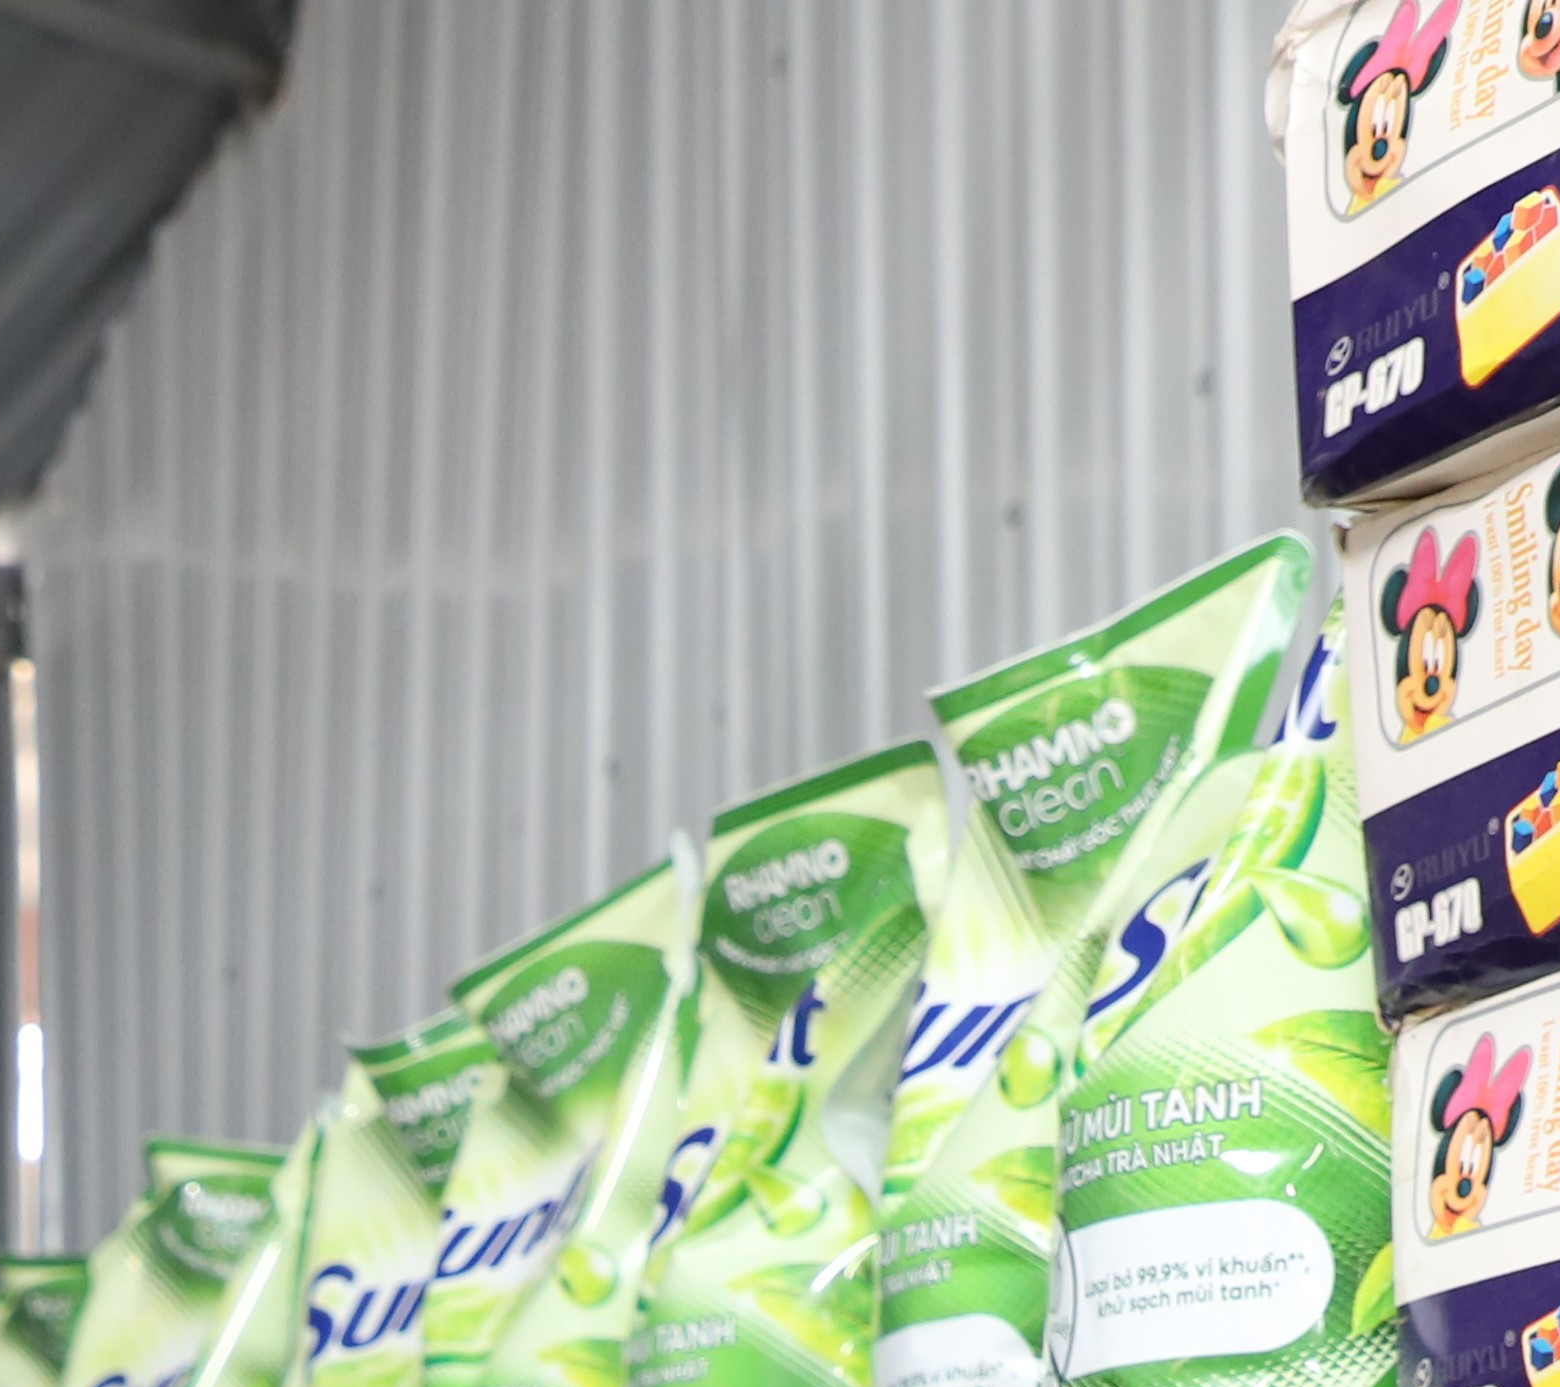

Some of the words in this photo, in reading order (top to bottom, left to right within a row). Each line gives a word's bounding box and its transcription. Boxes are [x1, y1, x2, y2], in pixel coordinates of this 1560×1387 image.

[1464, 63, 1510, 121] day
[1322, 336, 1425, 438] GP-670
[1505, 482, 1538, 616] Smiling
[1507, 617, 1541, 671] day
[998, 757, 1126, 838] clean
[1394, 878, 1483, 964] GP-670
[1140, 1078, 1263, 1131] TANH
[1152, 1132, 1226, 1168] NHẬT
